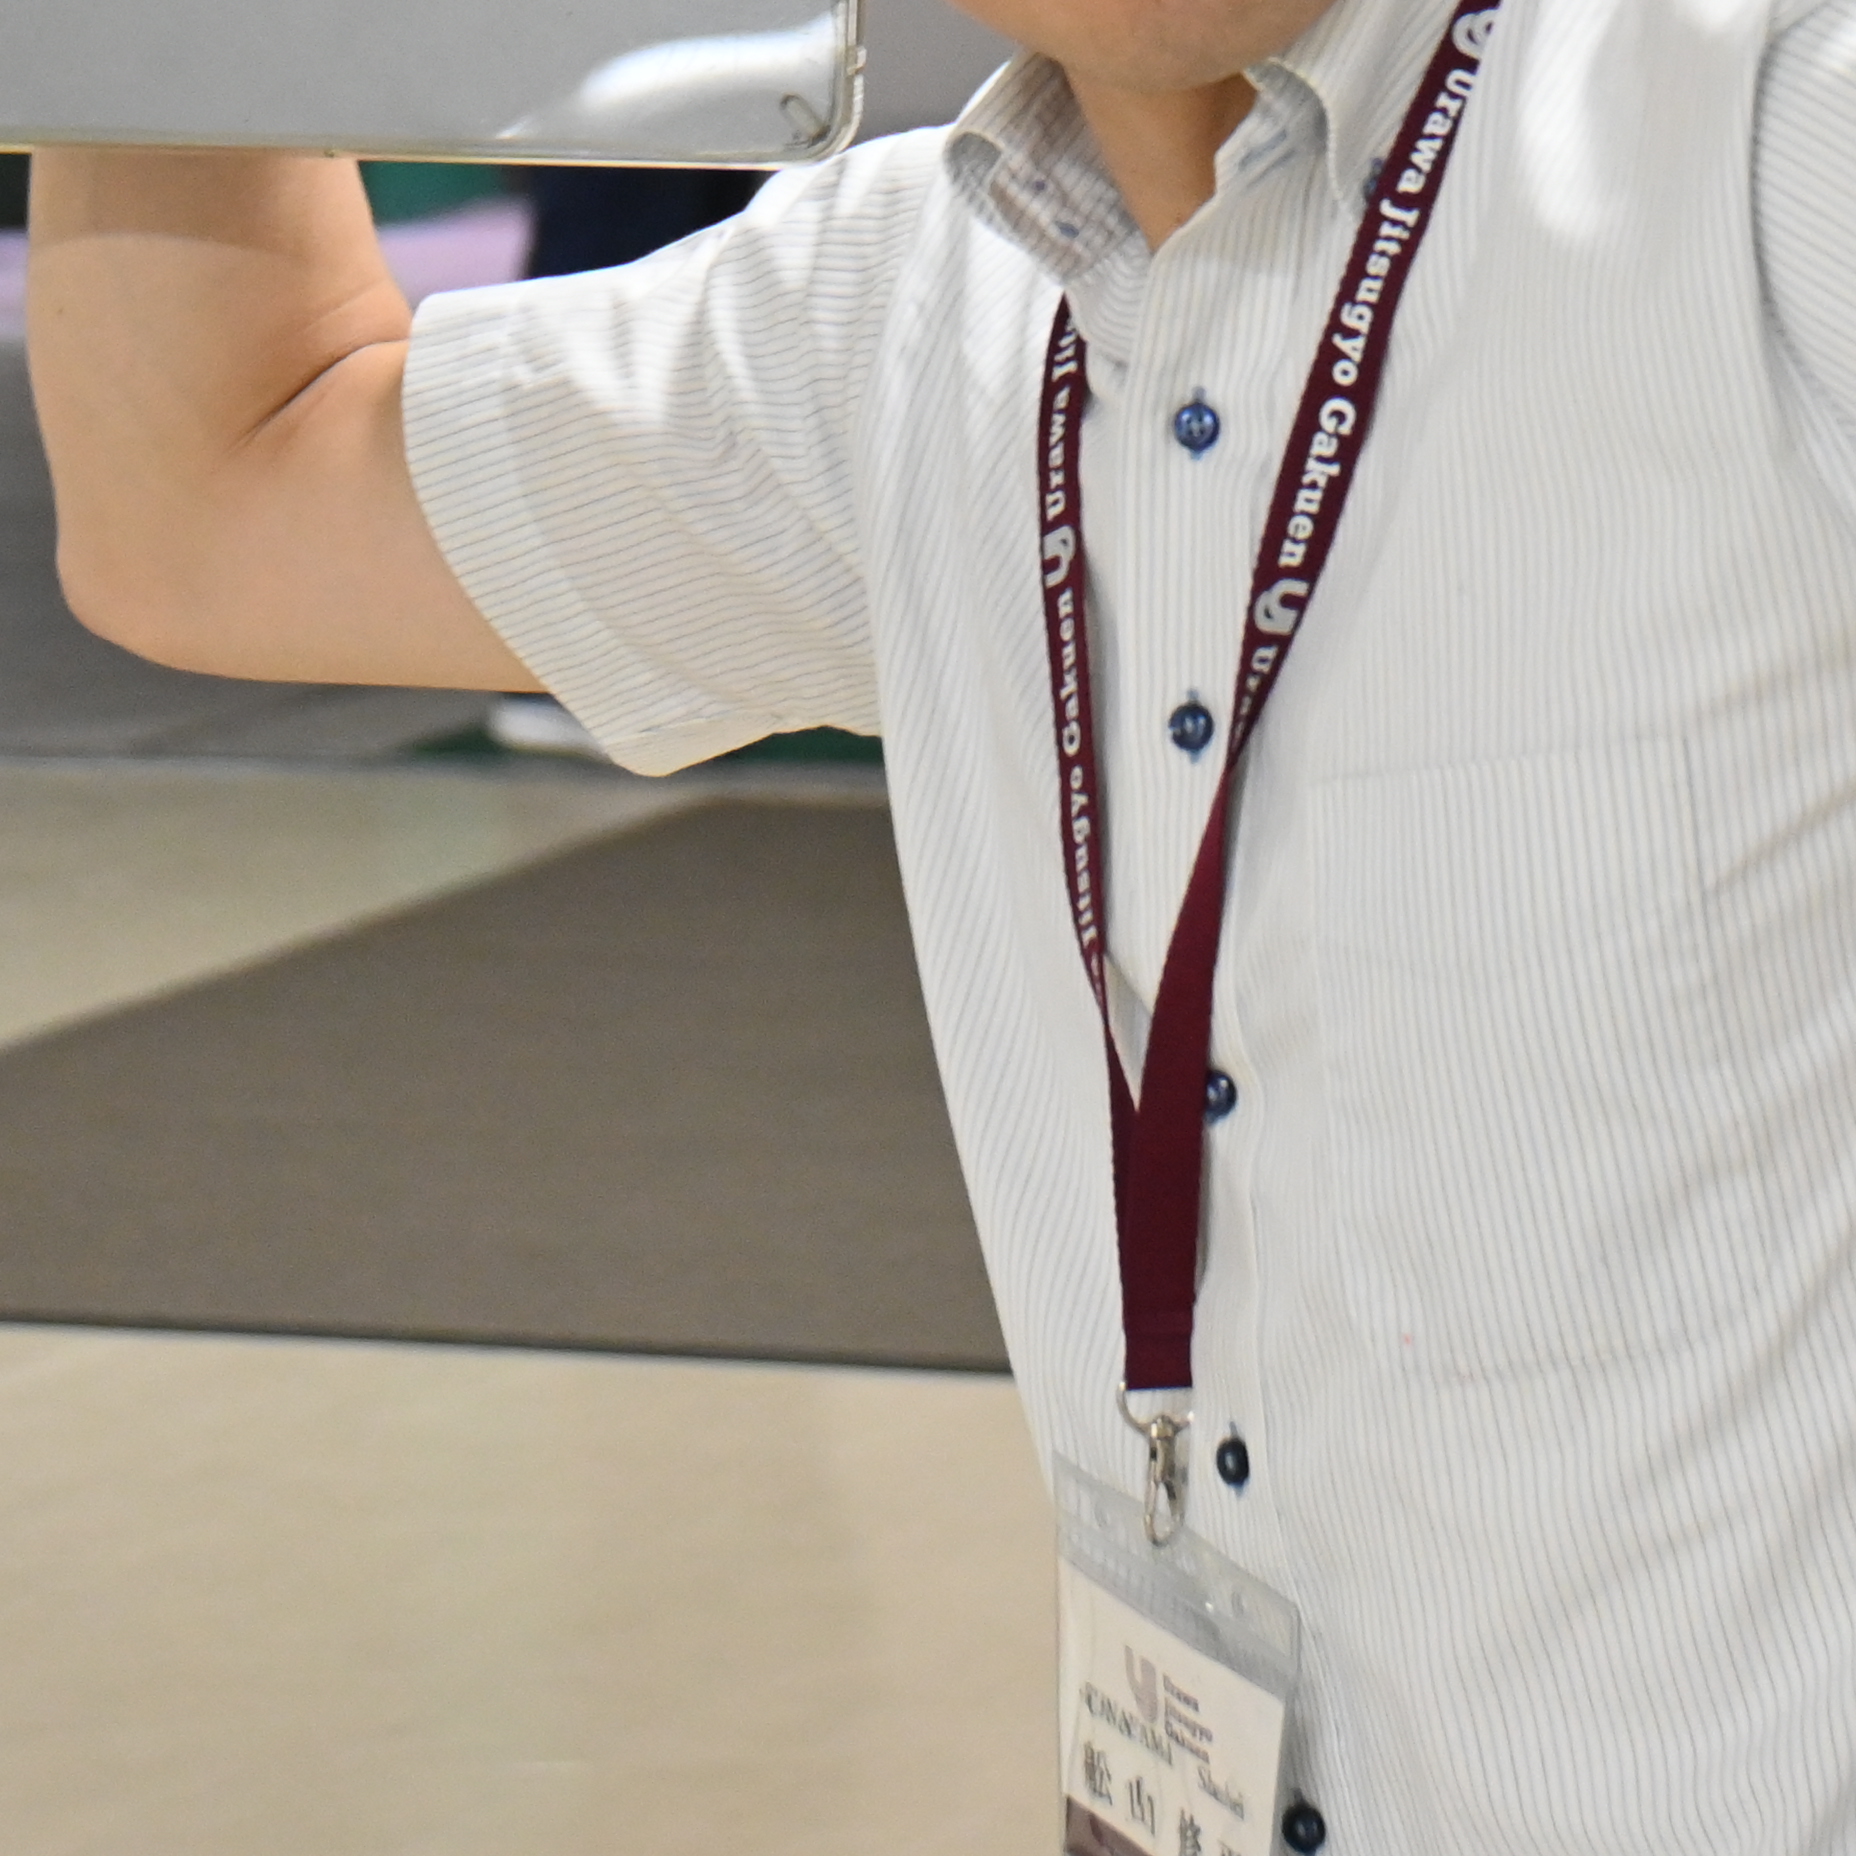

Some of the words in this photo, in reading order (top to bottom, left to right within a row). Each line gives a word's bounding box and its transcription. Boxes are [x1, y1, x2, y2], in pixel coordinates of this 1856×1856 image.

[1396, 68, 1477, 194] Urawa
[1331, 197, 1420, 387] Jitsugyo
[1277, 396, 1358, 568] Gakuen
[1055, 587, 1082, 758] Gakuen
